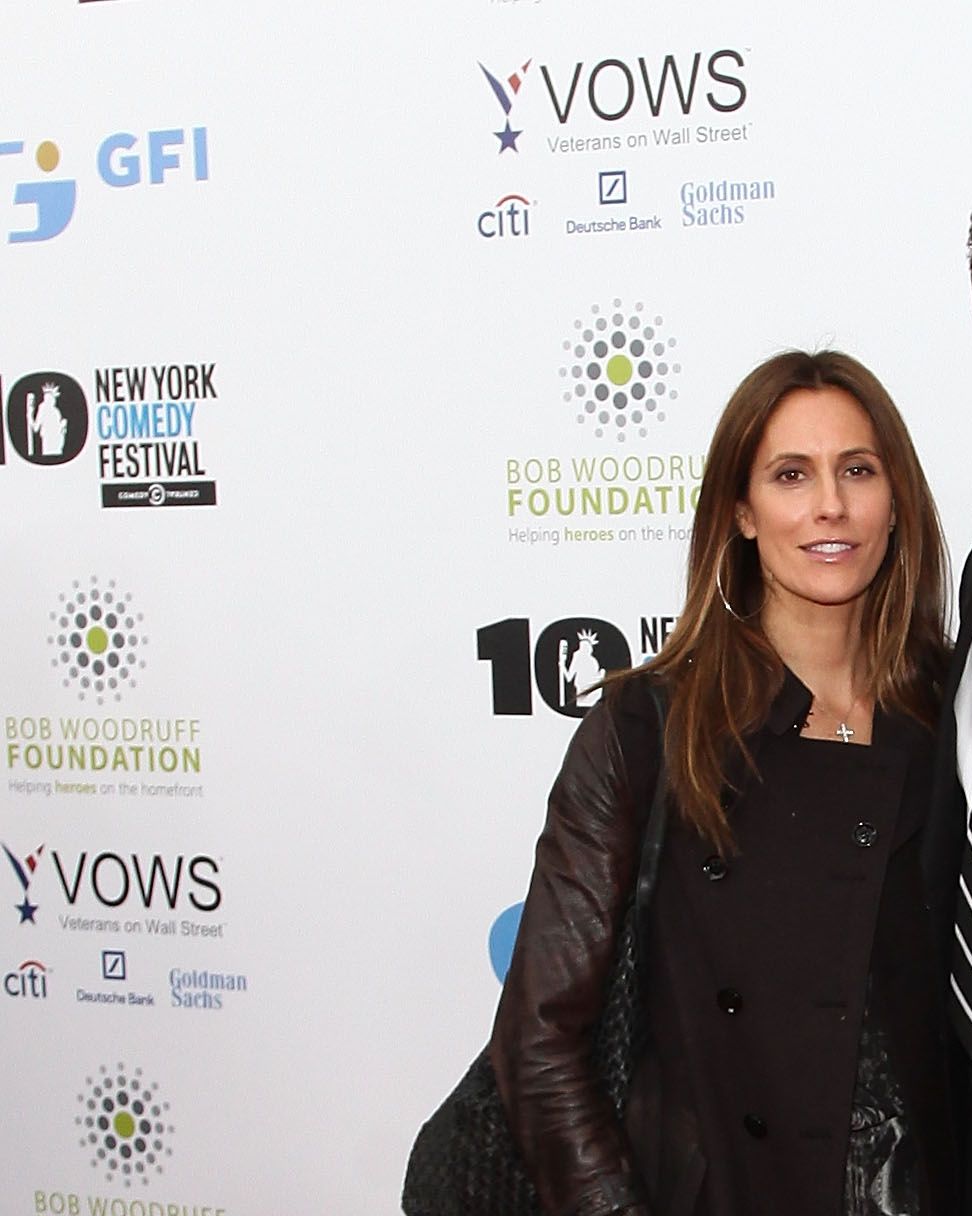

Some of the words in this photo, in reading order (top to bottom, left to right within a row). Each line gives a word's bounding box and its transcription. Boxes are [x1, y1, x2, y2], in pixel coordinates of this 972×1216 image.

[540, 50, 747, 124] VOWS
[547, 135, 621, 153] Veterans
[627, 133, 648, 149] on
[653, 128, 690, 146] Wall
[696, 125, 748, 143] Street
[97, 127, 208, 187] GFI
[680, 180, 776, 205] Goldman
[477, 202, 529, 238] citi
[566, 217, 626, 234] Deutsche
[629, 216, 662, 231] Bank
[682, 204, 745, 227] Sachs
[95, 366, 147, 402] NEW
[152, 363, 217, 400] YORK
[96, 402, 196, 440] COMEDY
[99, 441, 205, 478] FESTIVAL
[507, 458, 561, 484] BOB
[508, 528, 560, 545] Helping
[564, 529, 614, 542] heroes
[618, 529, 637, 542] on
[641, 525, 664, 541] the
[477, 617, 632, 719] 10
[5, 716, 51, 740] BOB
[60, 717, 200, 742] WOODRUFF
[6, 744, 201, 773] FOUNDATION
[8, 779, 51, 796] Helping
[55, 780, 97, 795] heroes
[99, 783, 115, 795] on
[118, 781, 138, 796] the
[52, 851, 222, 912] VOWS
[58, 915, 120, 932] Veterans
[124, 919, 141, 933] on
[147, 918, 176, 936] Wall
[182, 922, 224, 938] Street
[4, 967, 47, 998] citi
[169, 968, 247, 992] Goldman
[76, 989, 126, 1005] Deutsche
[129, 994, 155, 1006] Bank
[171, 989, 223, 1009] Sachs
[35, 1190, 80, 1216] BOB
